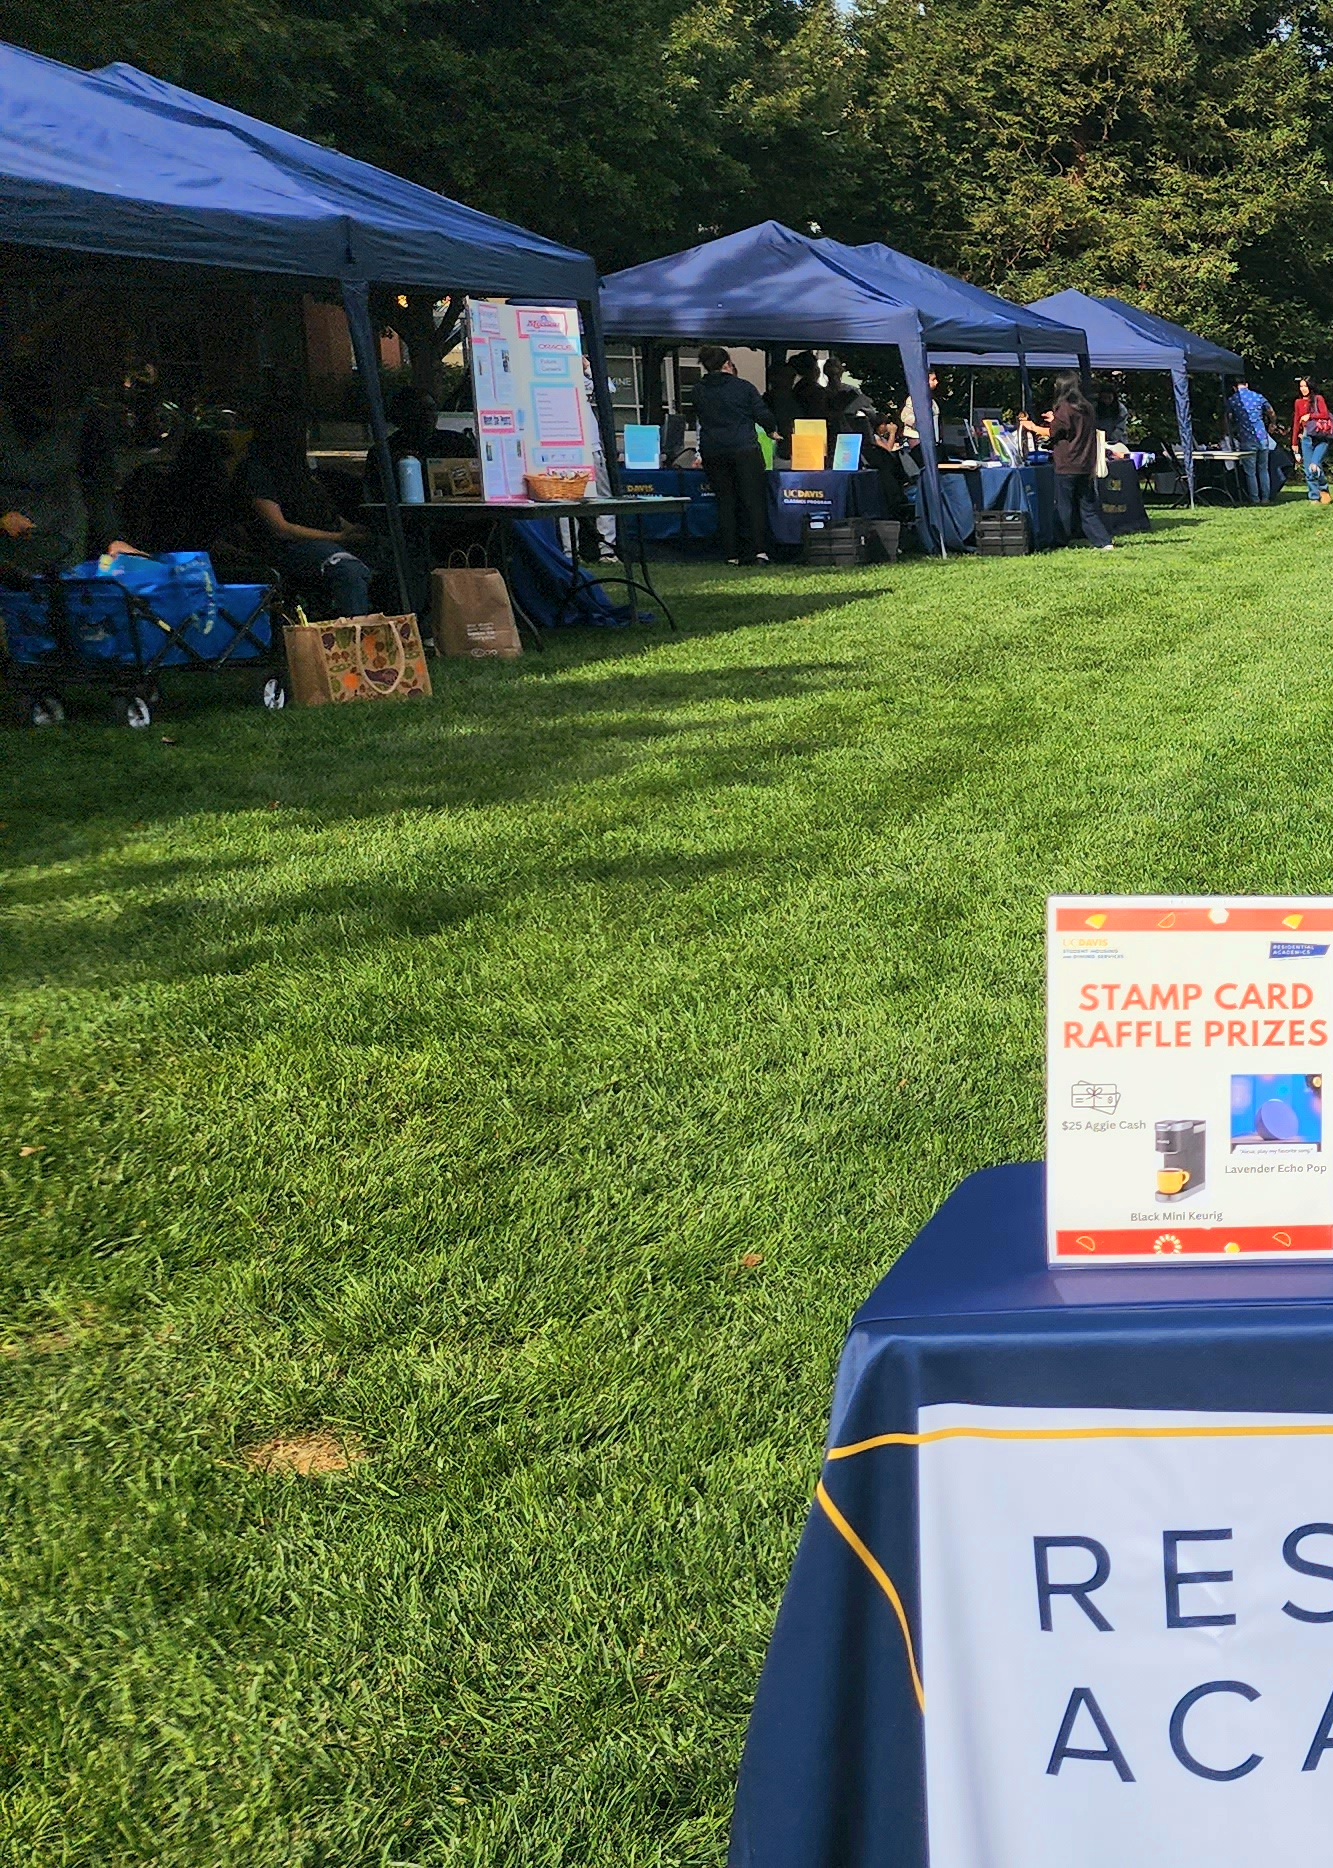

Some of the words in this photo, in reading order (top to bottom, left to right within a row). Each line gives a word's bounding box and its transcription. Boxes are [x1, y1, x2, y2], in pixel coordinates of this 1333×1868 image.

[538, 343, 572, 351] ORACLE
[1079, 983, 1203, 1012] STAMP
[1214, 982, 1314, 1010] CARD
[1063, 1020, 1192, 1048] RAFFLE
[1204, 1020, 1329, 1048] PRIZES
[1061, 1120, 1083, 1132] $25
[1084, 1120, 1117, 1133] Aggie
[1119, 1119, 1147, 1130] Cash
[1225, 1164, 1276, 1174] Lavender
[1278, 1163, 1304, 1173] Echo
[1306, 1164, 1327, 1174] Pop
[1130, 1212, 1160, 1222] Black
[1162, 1211, 1186, 1221] Mini
[1188, 1210, 1224, 1224] Keurig
